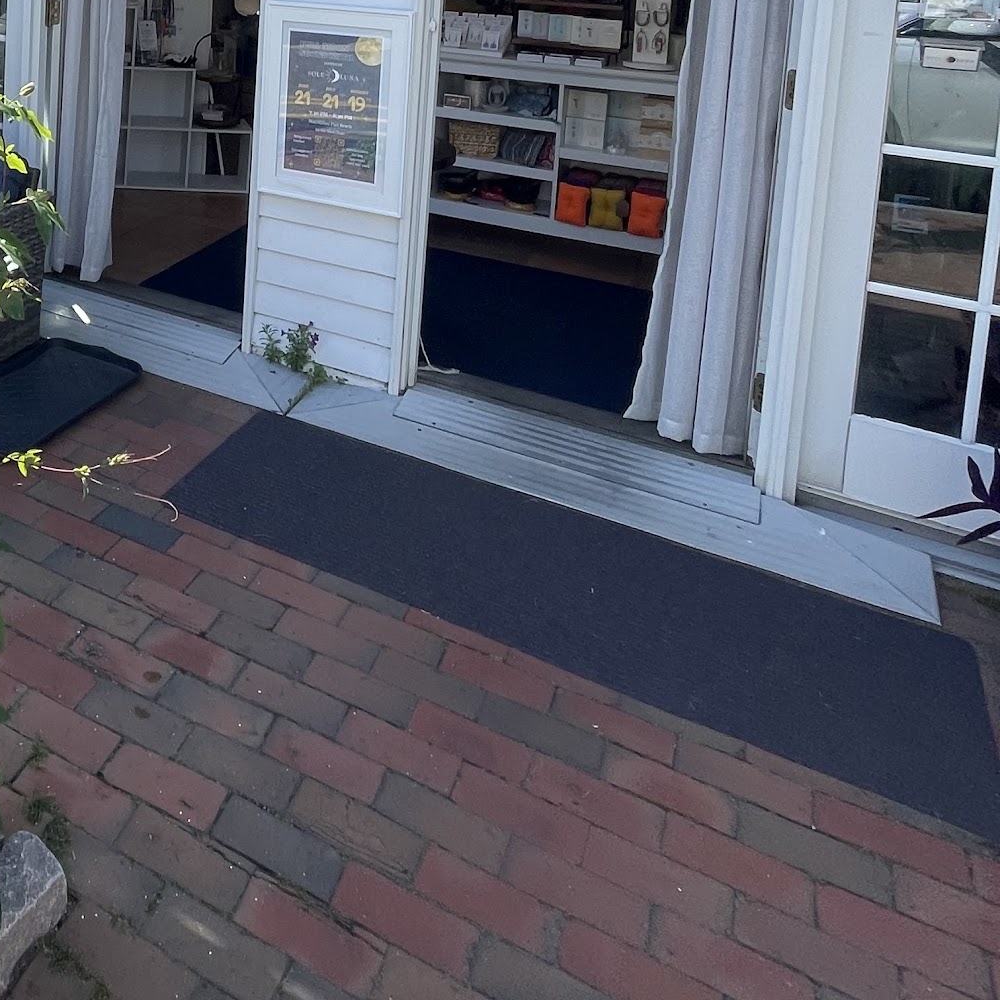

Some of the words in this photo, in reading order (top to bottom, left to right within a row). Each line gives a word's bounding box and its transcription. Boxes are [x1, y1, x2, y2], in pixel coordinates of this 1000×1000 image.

[294, 89, 311, 106] 21
[322, 93, 339, 109] 21
[347, 95, 366, 112] 19
